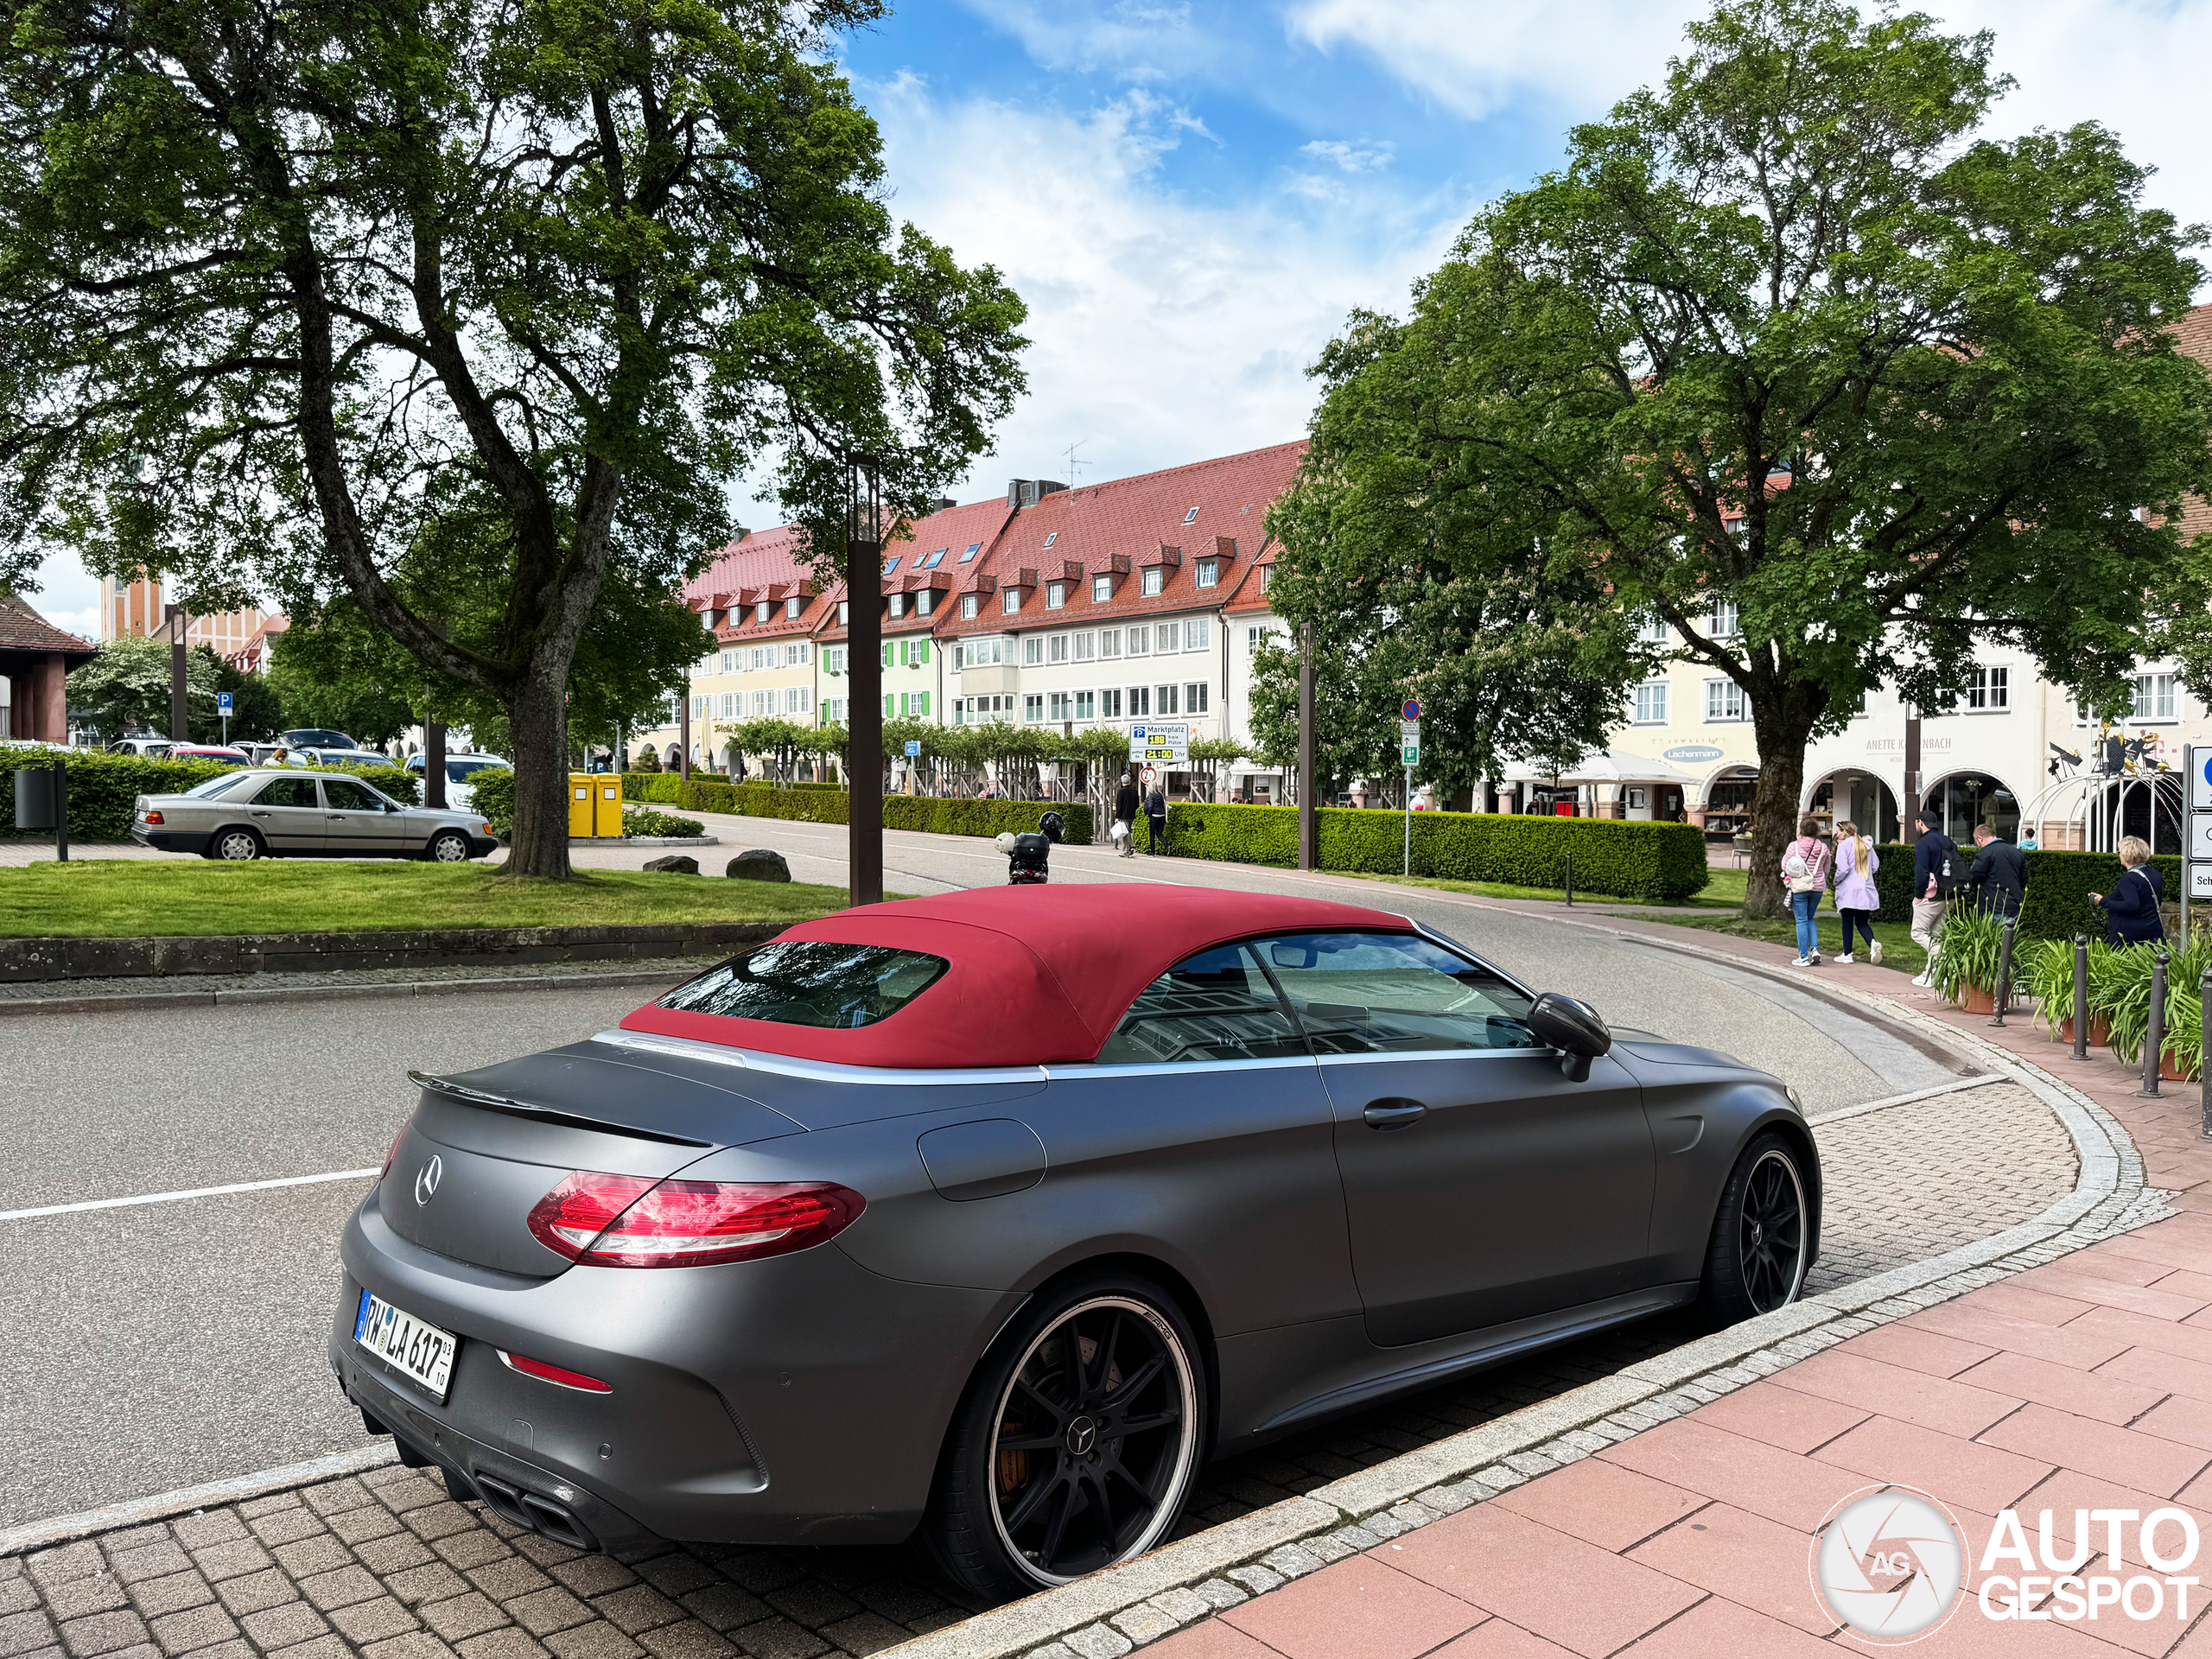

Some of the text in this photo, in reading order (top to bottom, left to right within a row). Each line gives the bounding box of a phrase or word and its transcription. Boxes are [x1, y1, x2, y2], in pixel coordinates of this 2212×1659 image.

[221, 694, 230, 706] P
[1149, 735, 1166, 745] 188
[1866, 739, 1896, 750] ANETTE
[1147, 750, 1173, 759] 21:00
[1668, 749, 1719, 759] Lachenmann
[1152, 1318, 1173, 1340] AMG
[362, 1299, 443, 1379] RW LA 617
[442, 1342, 452, 1356] 03
[435, 1371, 445, 1386] 10
